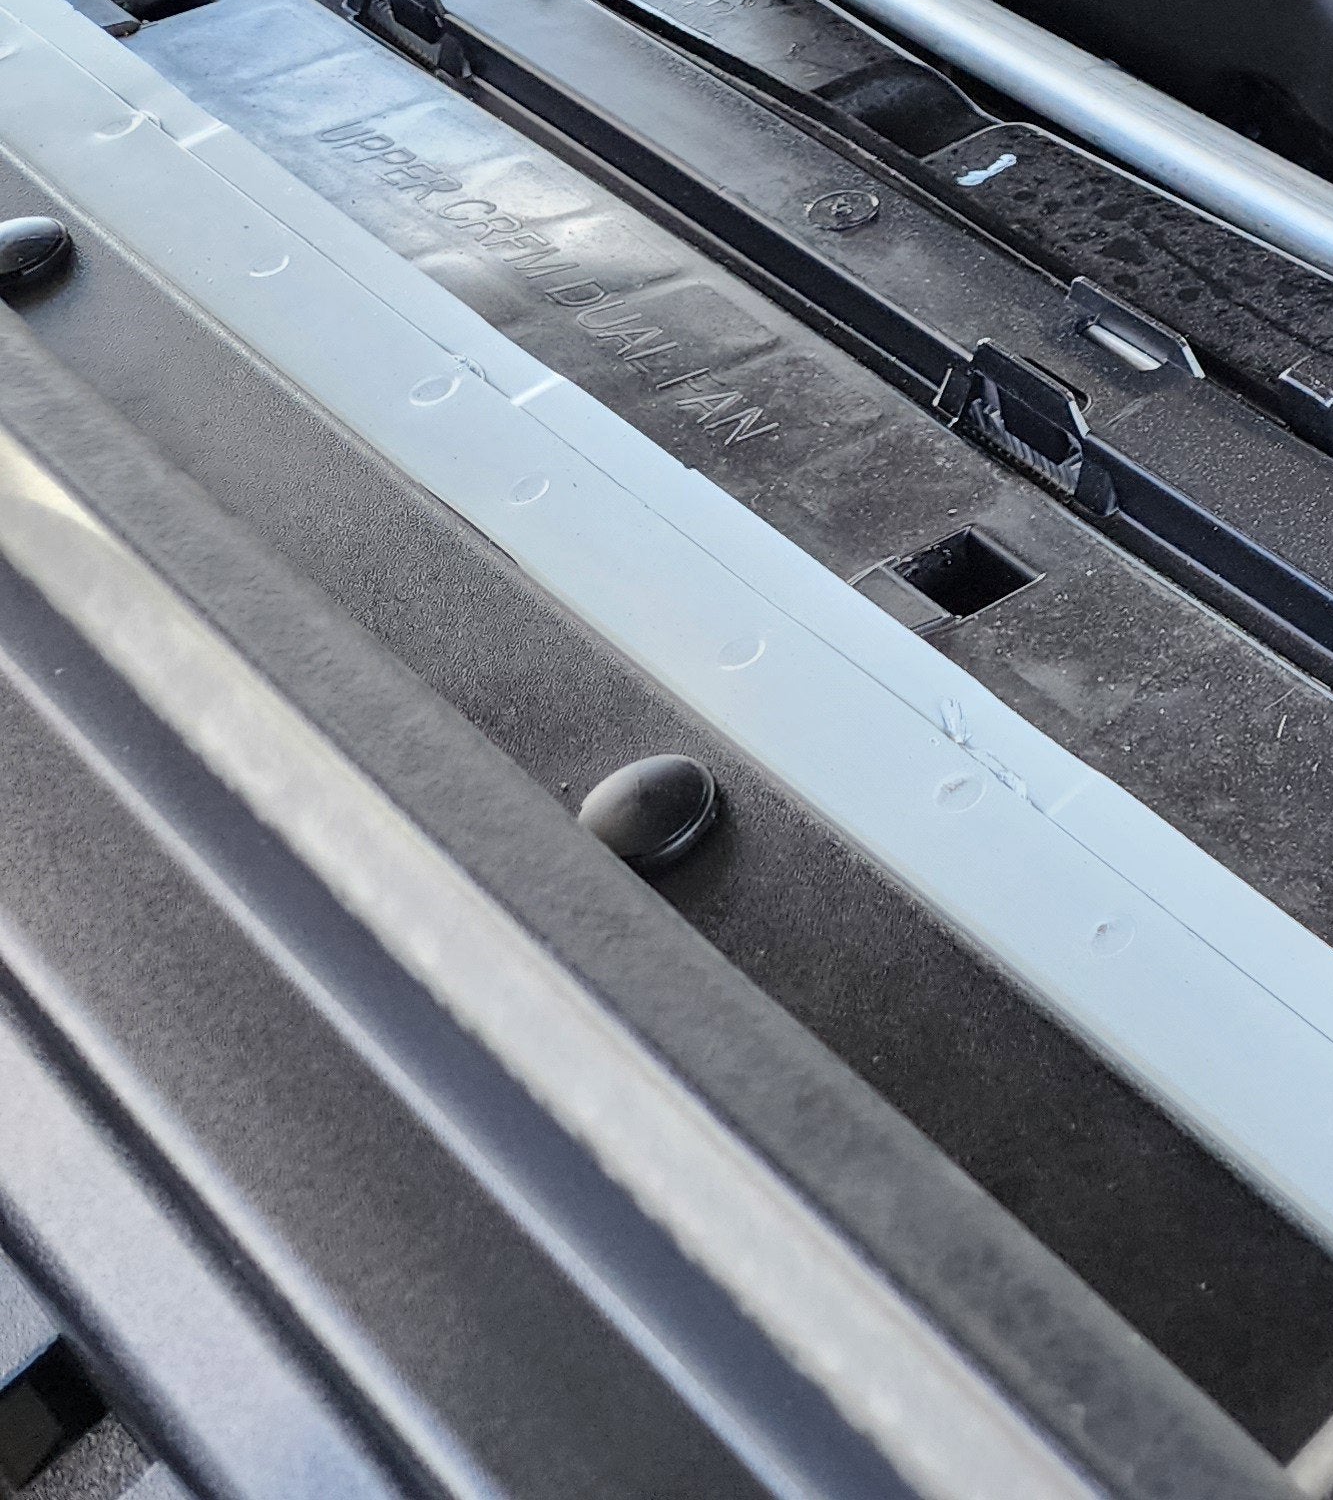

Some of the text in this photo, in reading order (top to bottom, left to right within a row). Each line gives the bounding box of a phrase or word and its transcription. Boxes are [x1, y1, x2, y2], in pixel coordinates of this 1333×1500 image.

[314, 121, 780, 447] UPPER CRFM DUAL FAN
